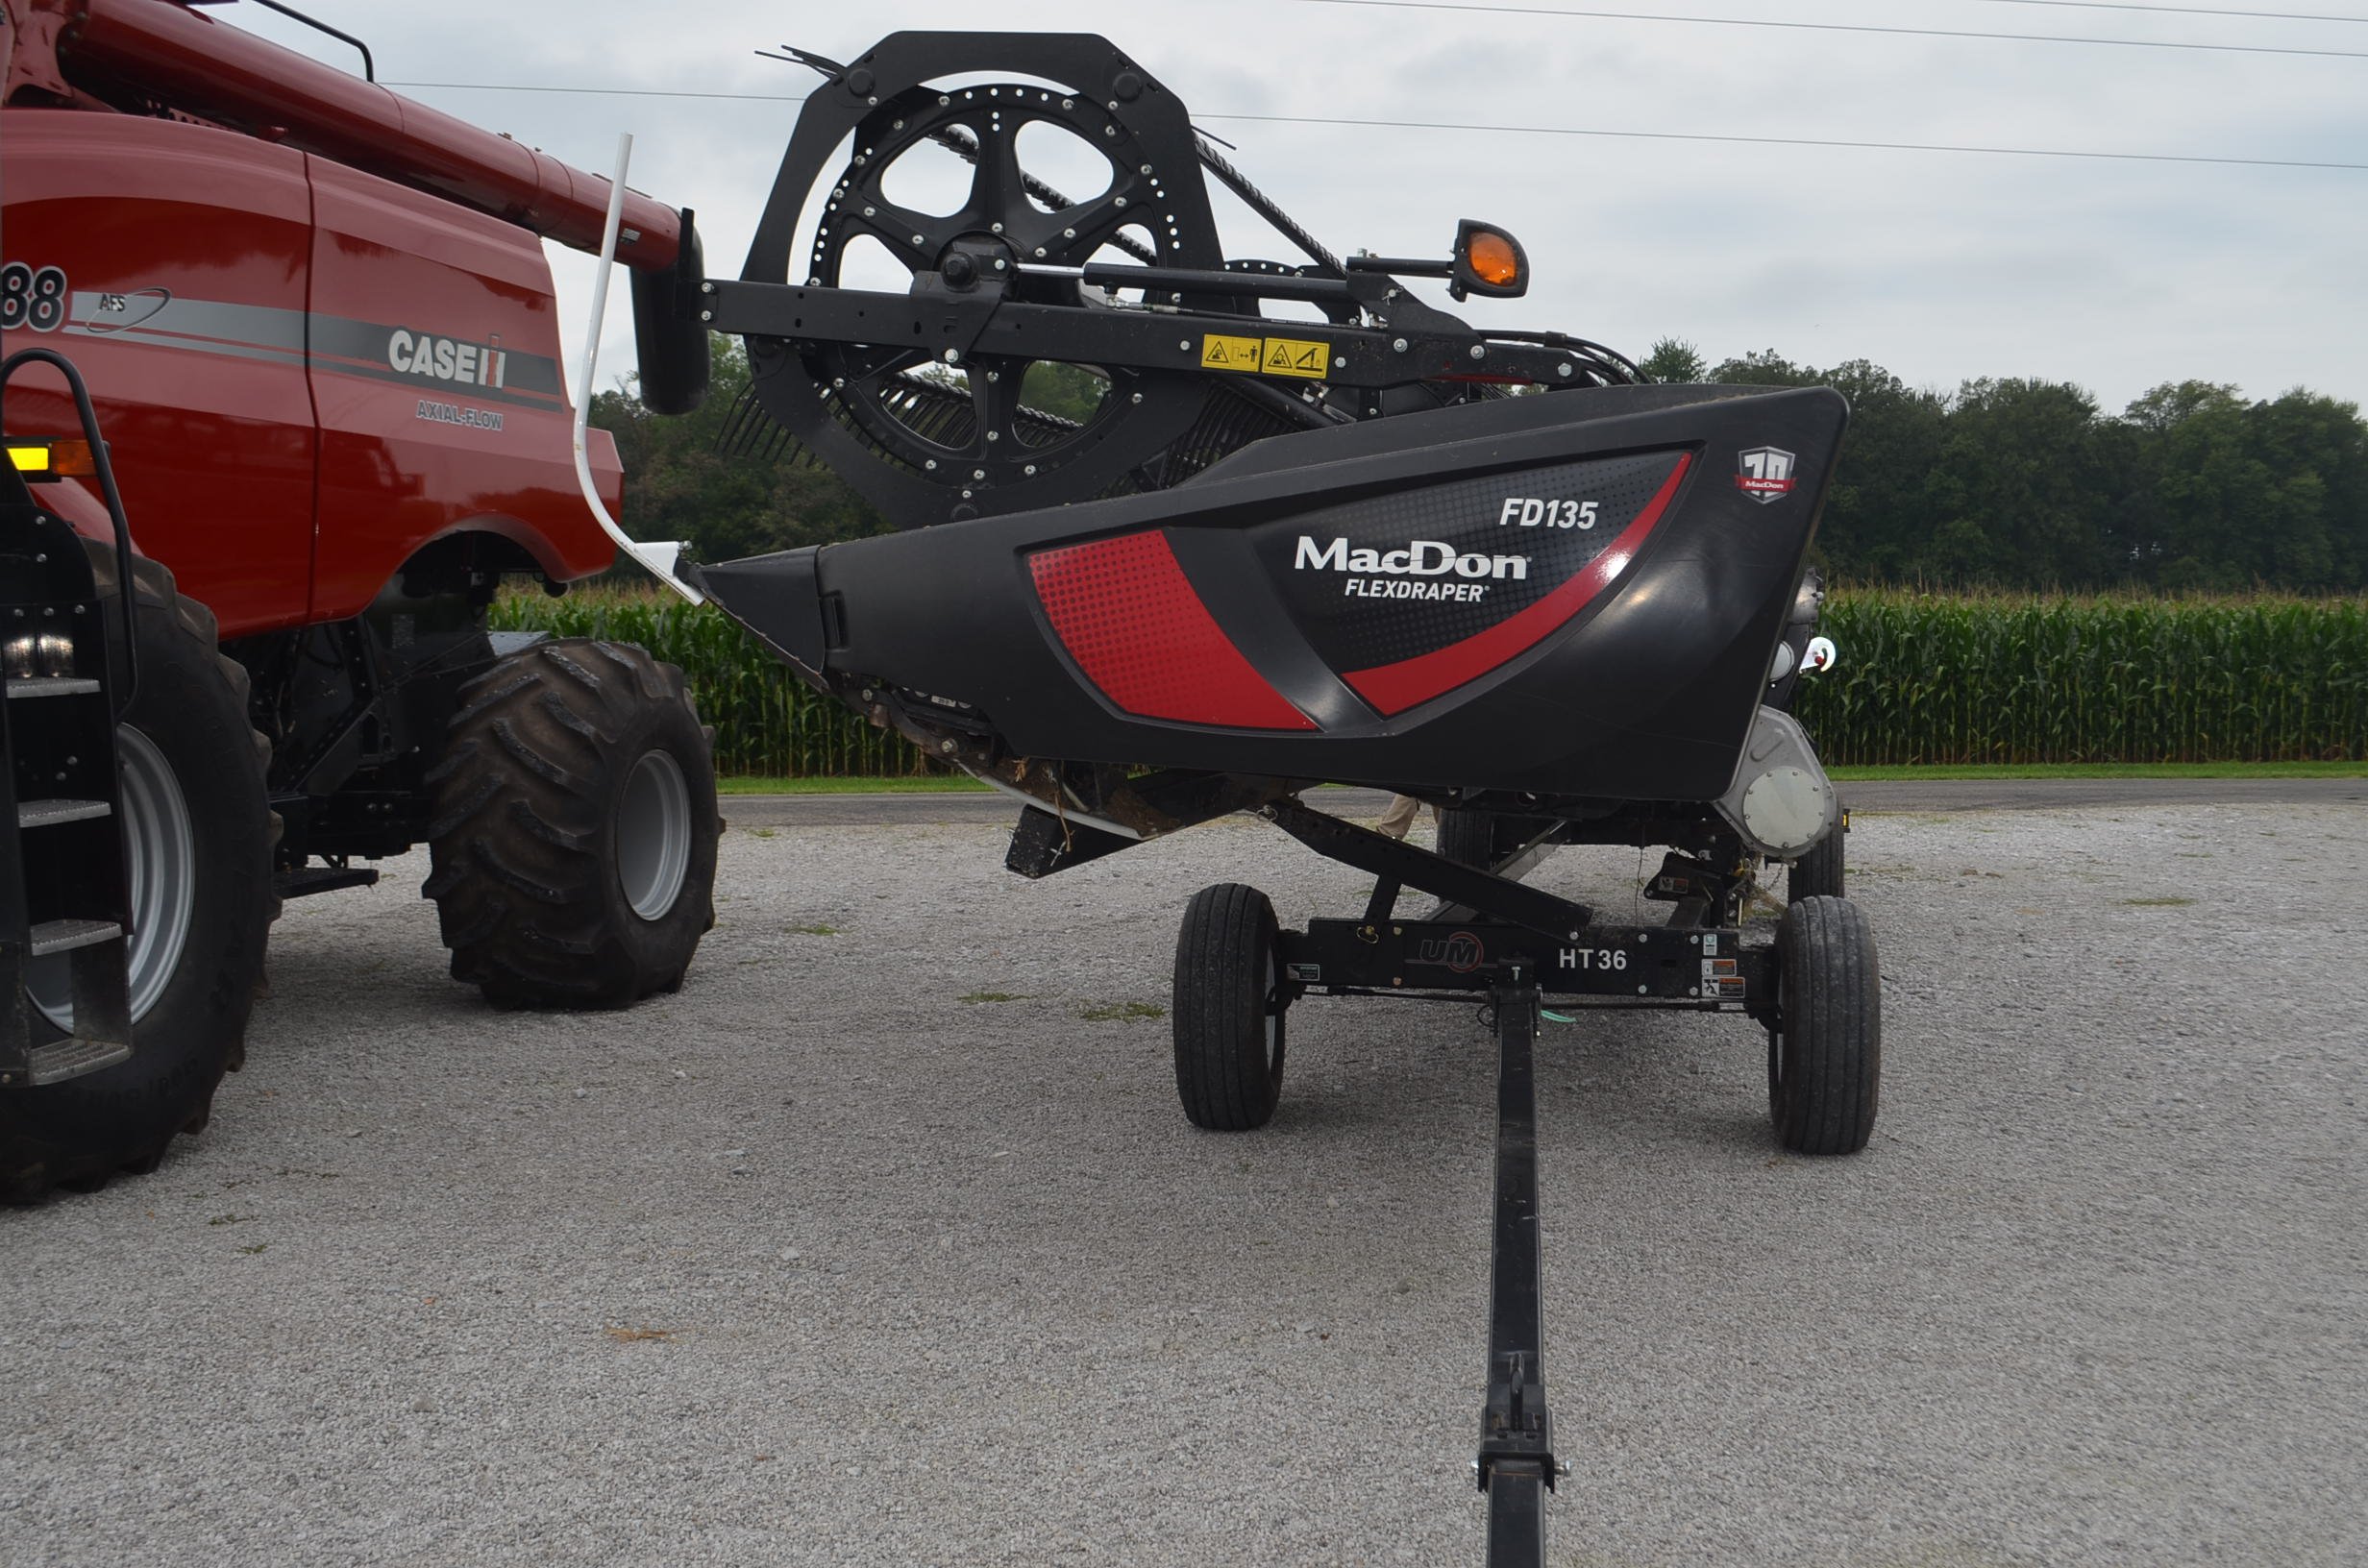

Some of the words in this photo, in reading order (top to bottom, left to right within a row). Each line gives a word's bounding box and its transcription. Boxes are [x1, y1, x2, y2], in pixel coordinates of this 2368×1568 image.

[1, 262, 67, 332] 88
[99, 293, 126, 312] AFS
[416, 400, 504, 431] AXIAL-FLOW
[1745, 480, 1784, 489] MacDon
[1499, 498, 1599, 529] FD135
[1419, 939, 1478, 964] UM
